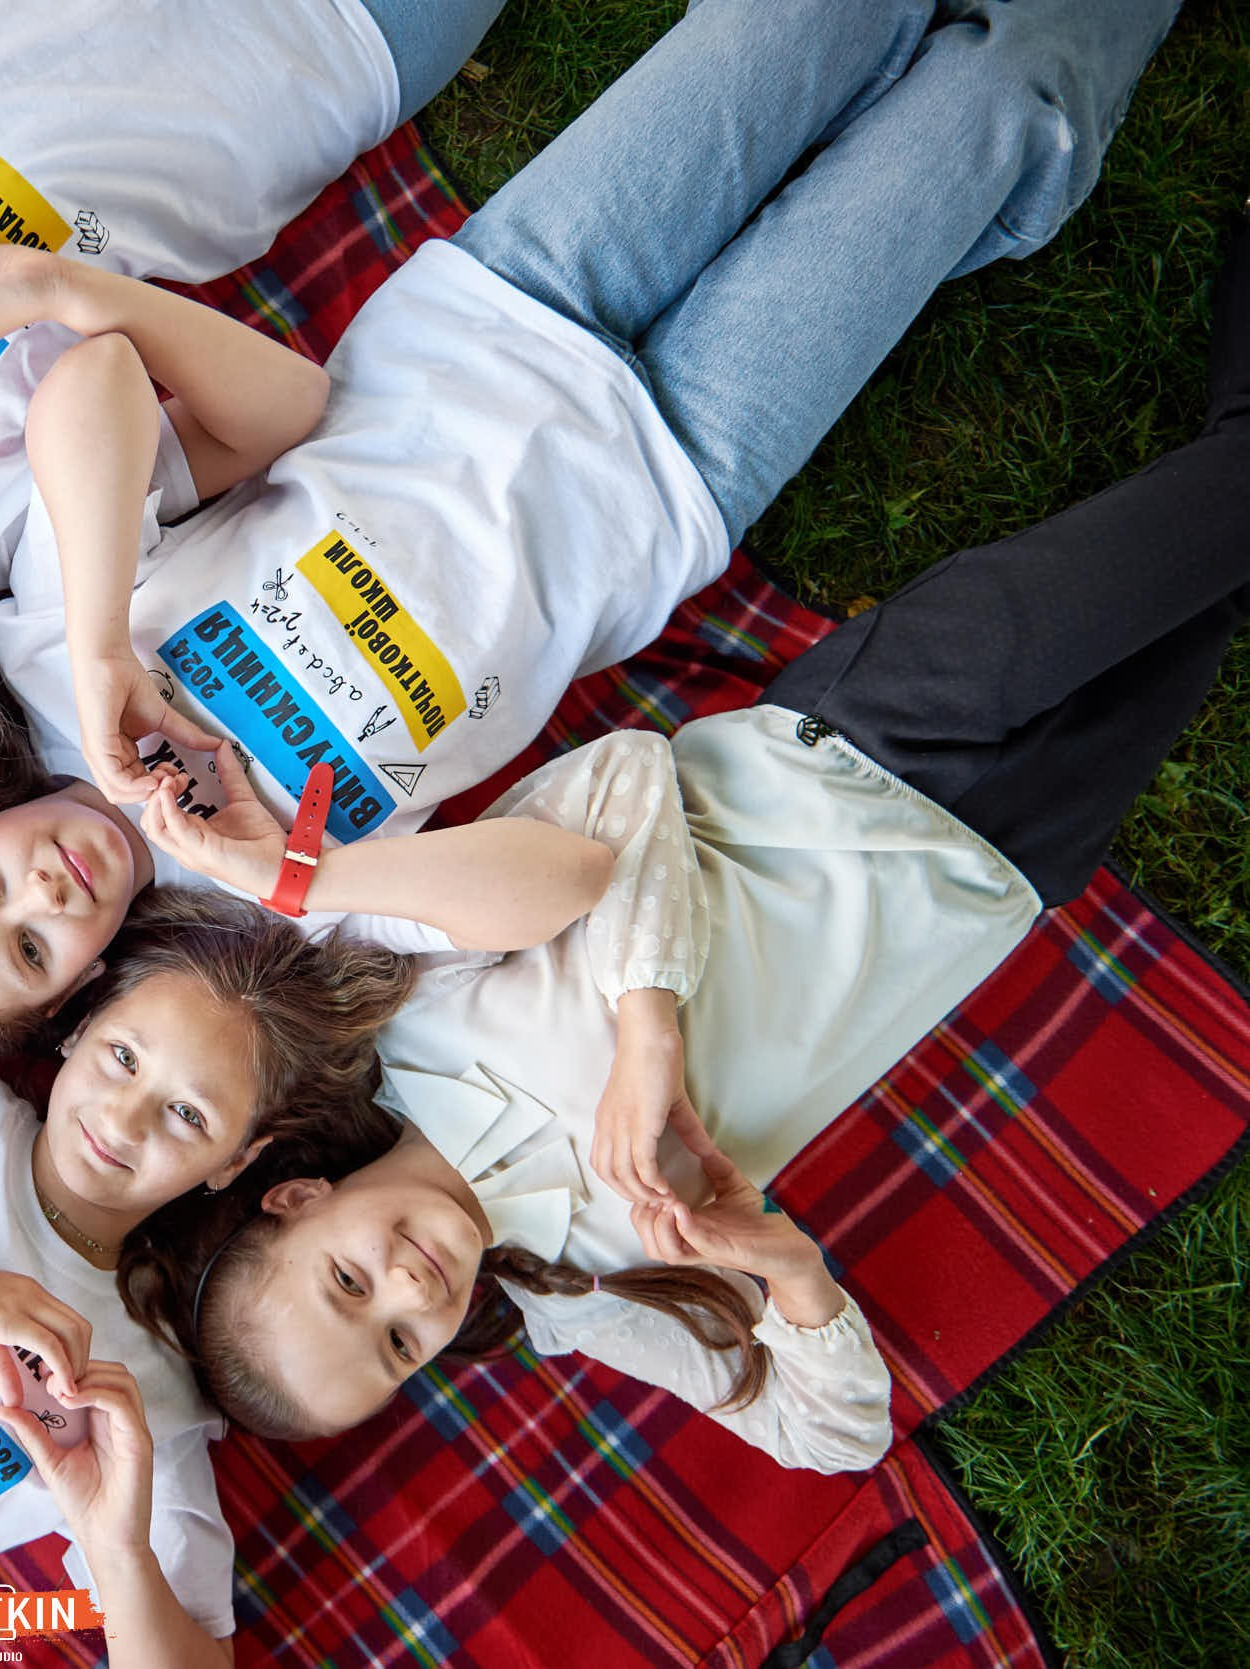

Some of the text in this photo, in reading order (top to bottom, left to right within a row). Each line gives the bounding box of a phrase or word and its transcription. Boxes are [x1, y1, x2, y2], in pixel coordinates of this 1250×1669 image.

[324, 539, 403, 623] ШКОЛИ
[169, 638, 224, 700] 2024
[344, 612, 446, 739] ПОЧАТКОВОЇ
